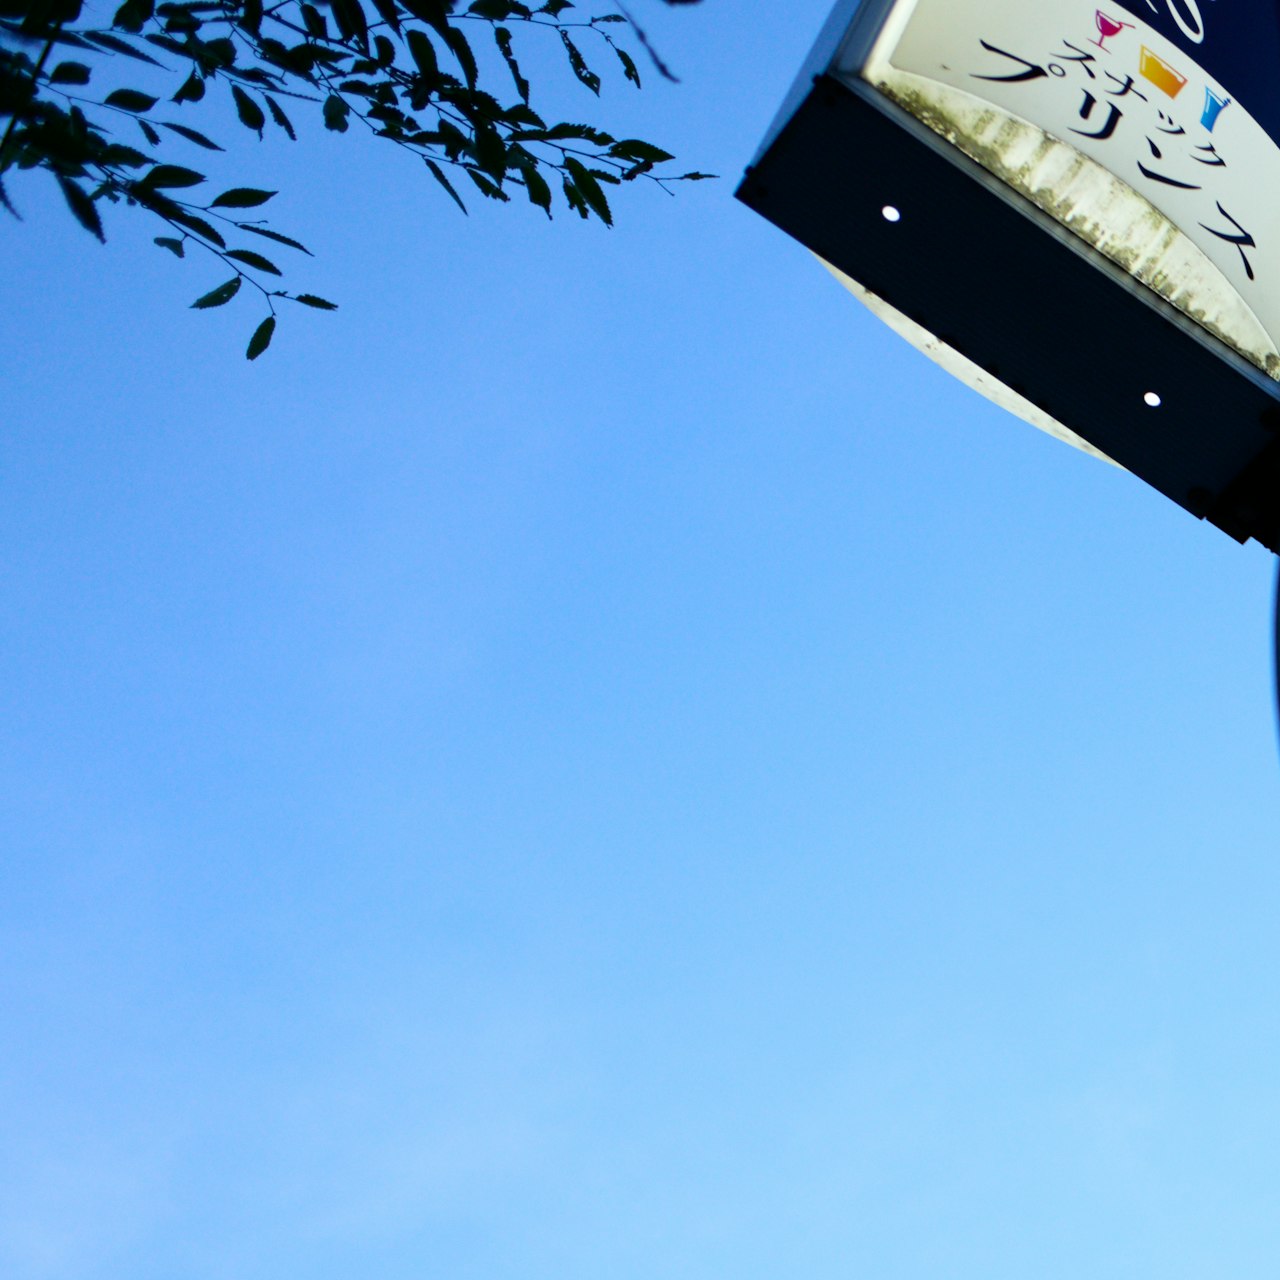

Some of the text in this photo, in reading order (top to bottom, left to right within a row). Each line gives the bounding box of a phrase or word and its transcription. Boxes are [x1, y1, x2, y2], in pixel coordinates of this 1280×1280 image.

[968, 38, 1256, 281] プリンス
[1049, 40, 1227, 167] スナック
